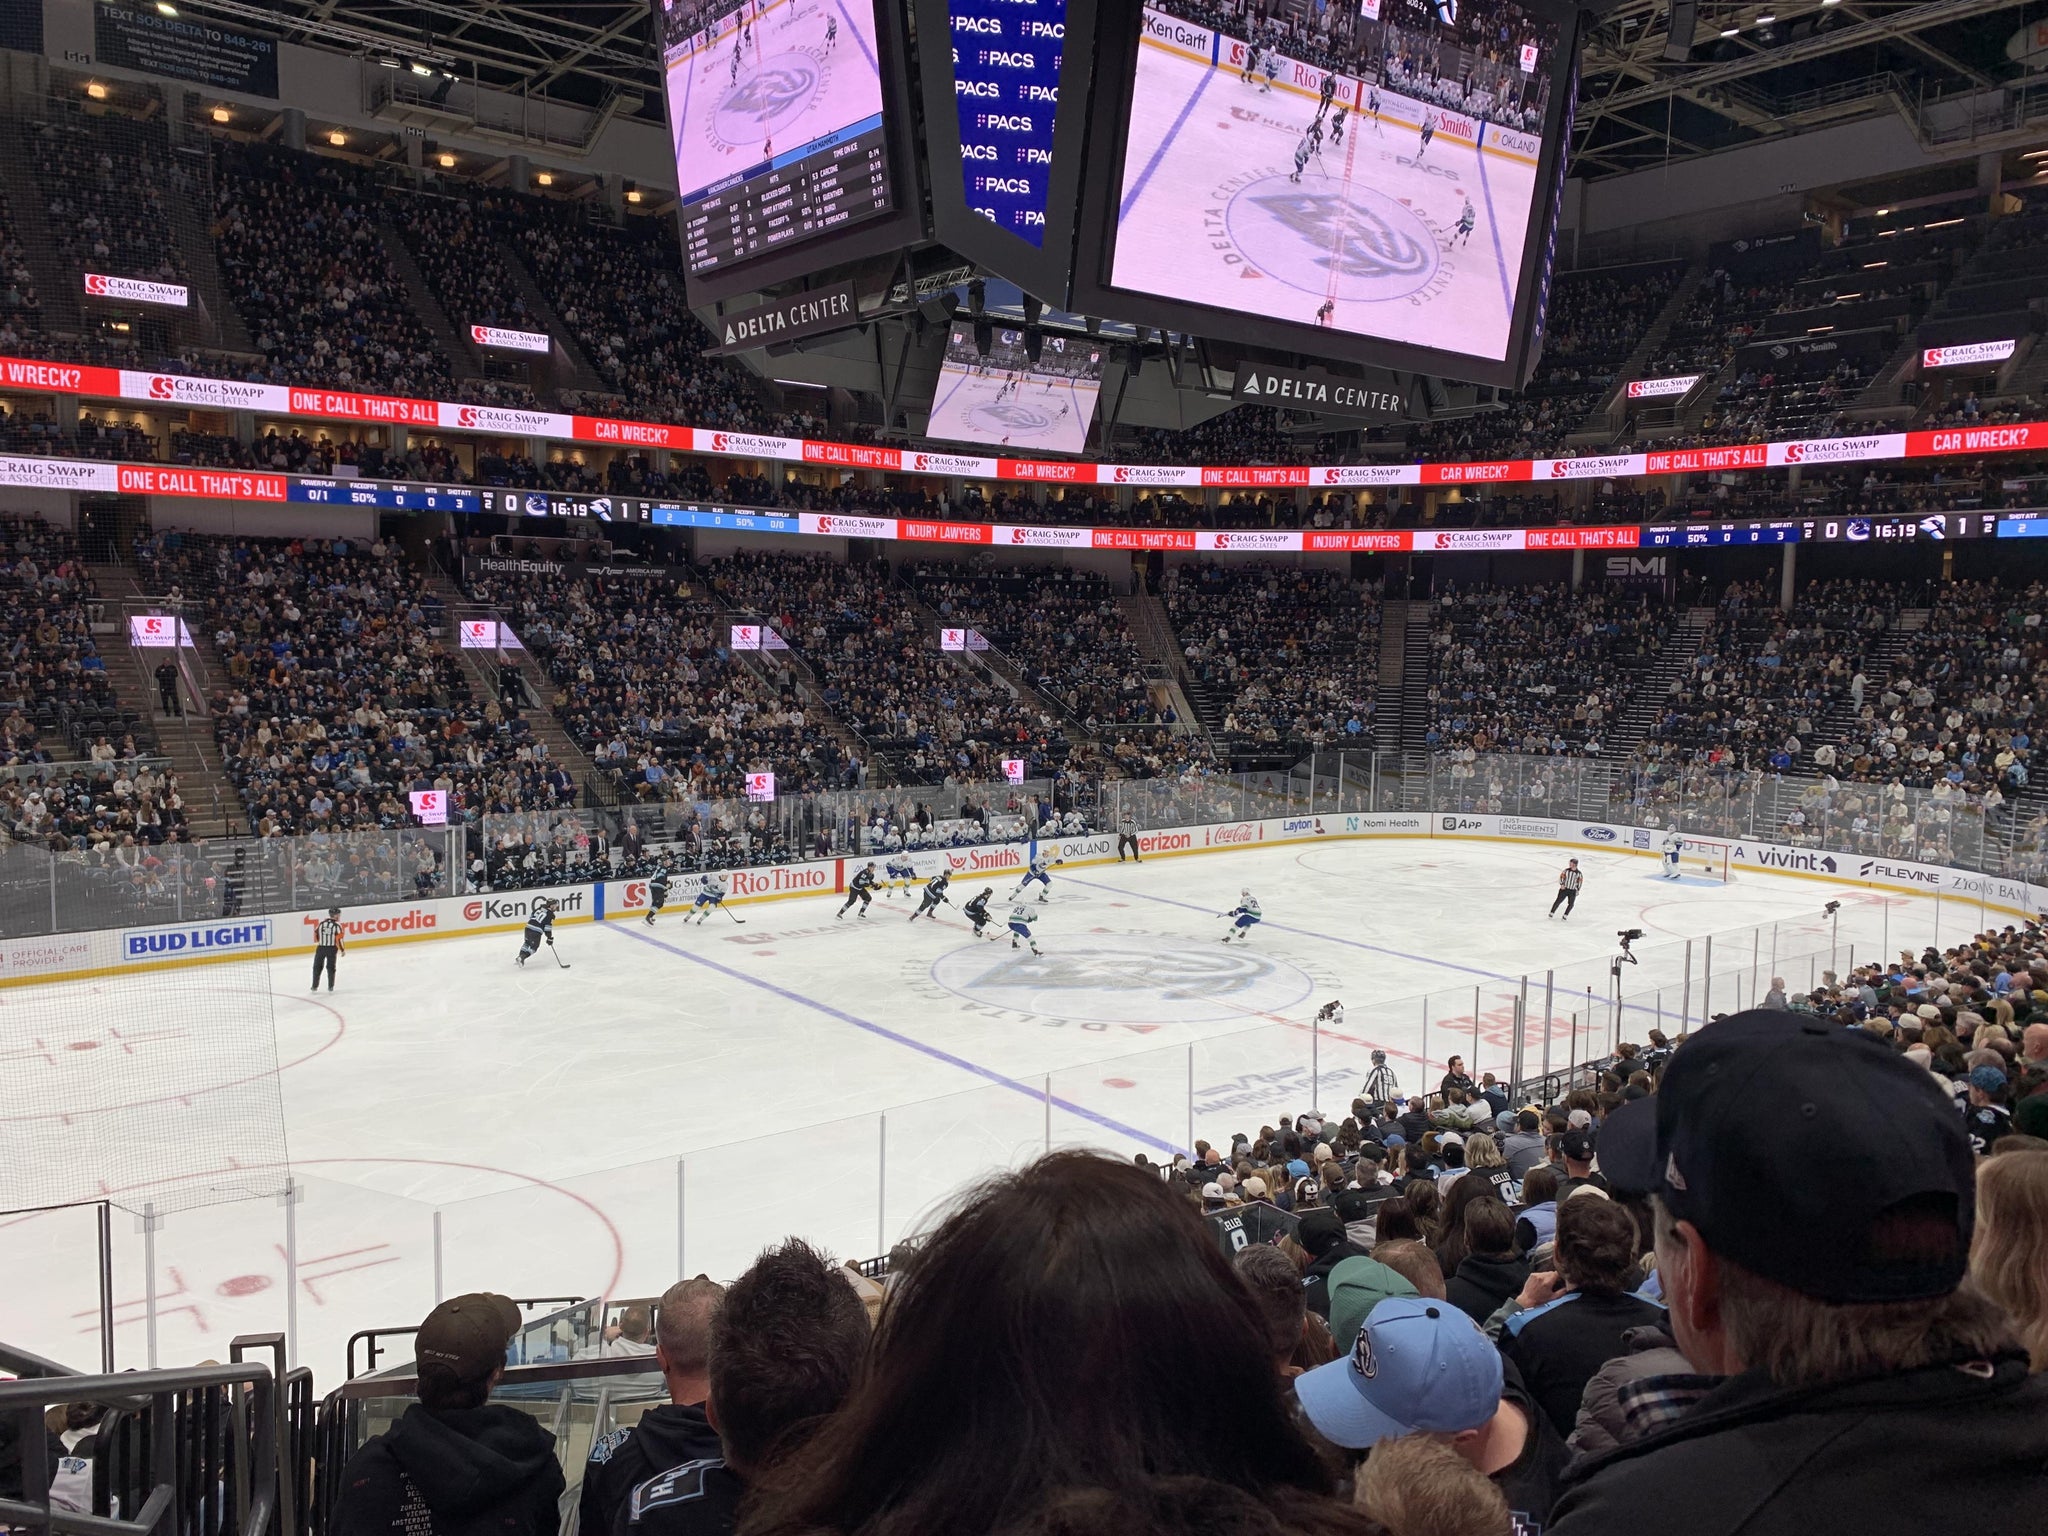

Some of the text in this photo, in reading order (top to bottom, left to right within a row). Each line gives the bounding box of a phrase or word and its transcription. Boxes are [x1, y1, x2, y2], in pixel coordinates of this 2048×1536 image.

[102, 6, 272, 53] TEXT SOS DELTA TO 848-261
[1146, 15, 1207, 51] Ken Garff
[1439, 111, 1473, 139] Smith's
[1501, 134, 1536, 154] OKLAND
[812, 172, 819, 181] 53
[1395, 155, 1460, 181] PACS
[872, 186, 884, 196] 0:17
[772, 198, 793, 213] ATTEMPTS
[874, 199, 885, 209] 1:31
[749, 240, 758, 249] 0/1
[108, 278, 187, 297] CRAIG SWAPP
[116, 288, 166, 302] ASSOCIATES
[738, 293, 849, 339] DELTA CENTER
[488, 329, 548, 344] CRAIG SWAPP
[1943, 342, 2014, 357] CRAIG SWAPP
[8, 363, 81, 388] WRECK?
[175, 379, 265, 398] CRAIG SWAPP
[1265, 376, 1400, 412] DELTA CENTER
[1643, 381, 1669, 390] CRAIG
[184, 392, 249, 406] ASSOCIATES
[293, 392, 436, 422] ONE CALL THAT'S ALL
[478, 409, 550, 427] CRAIG SWAPP
[595, 422, 669, 444] CAR WRECK?
[1933, 428, 2029, 450] CAR WRECK?
[728, 435, 787, 450] CRAIG SWAPP
[1804, 439, 1880, 453] CRAIG SWAPP
[805, 444, 900, 467] ONE CALL THAT'S ALL
[1702, 448, 1765, 467] THAT'S ALL
[47, 464, 96, 477] SWAPP
[1204, 469, 1308, 483] ONE CALL THAT'S ALL
[1341, 467, 1401, 478] CRAIG SWAPP
[8, 474, 78, 486] ASSOCIATES
[121, 470, 283, 498] ONE CALL THAT'S ALL
[308, 489, 463, 508] 0/1 50% 3
[505, 495, 588, 517] 0 16:19
[621, 503, 628, 518] 1
[736, 518, 785, 529] 50% 0/0
[832, 517, 885, 529] CRAIG SWAPP
[1825, 517, 1966, 538] 0 16:19 1
[906, 523, 981, 541] INJURY LAWYERS
[1528, 530, 1636, 546] ONE CALL THAT'S ALL
[1654, 534, 1708, 544] 0/1 50%
[480, 558, 562, 576] HealthEquity
[1606, 556, 1666, 576] SMI
[1283, 819, 1312, 833] Layton
[1364, 819, 1419, 828] Nomi Health
[1458, 819, 1482, 830] APP
[1502, 823, 1554, 833] INGREDIENTS
[1137, 832, 1190, 852] verizon
[1588, 828, 1611, 840] Ford
[1063, 840, 1110, 857] OKLAND
[970, 848, 1021, 869] Smith's
[1758, 847, 1818, 871] vivint
[1875, 865, 1940, 884] FILEVINE
[1952, 876, 1994, 895] ZIONS
[485, 899, 527, 919] Ken
[129, 924, 267, 955] BUD LIGHT
[12, 944, 88, 959] OFFICIAL CARE
[12, 955, 65, 968] PROVIDER
[391, 1516, 430, 1527] AMSTERDAM
[405, 1523, 432, 1532] BERLIN
